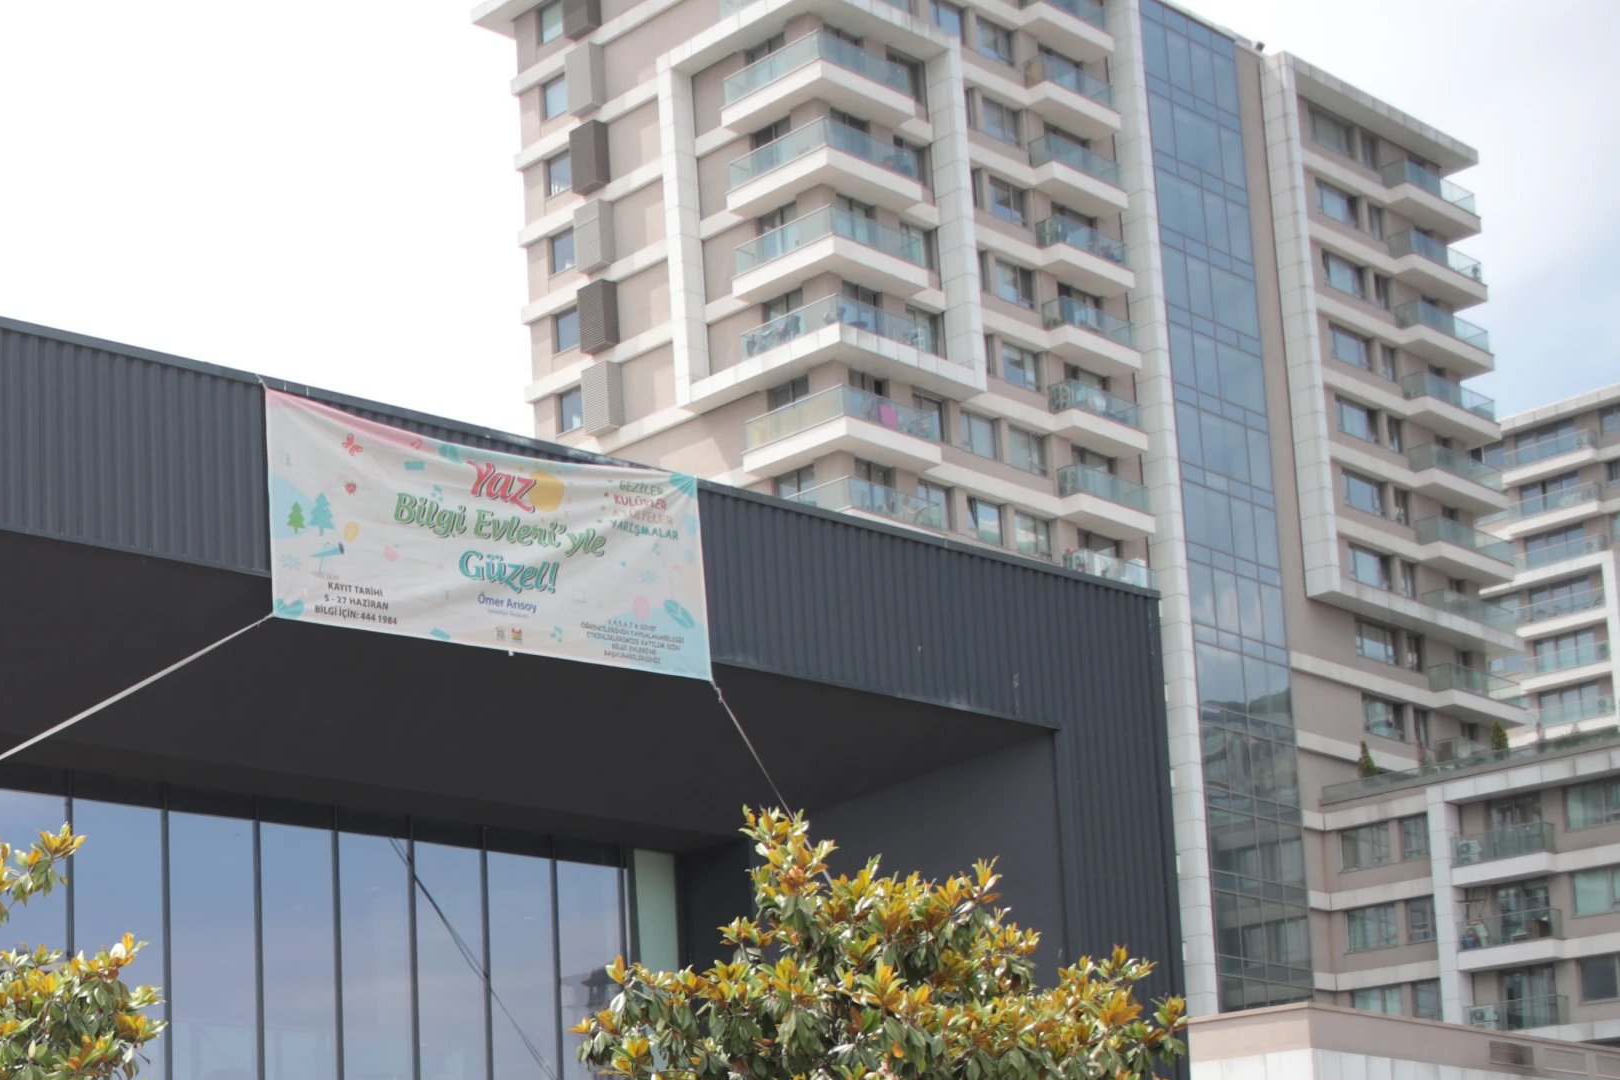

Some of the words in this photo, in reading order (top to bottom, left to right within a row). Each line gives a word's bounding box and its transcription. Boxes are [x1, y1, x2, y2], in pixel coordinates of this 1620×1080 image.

[466, 460, 536, 514] Yaz
[393, 493, 467, 538] Bilgi
[609, 519, 679, 541] YARIŞMALAR
[458, 549, 560, 594] Güzel!
[327, 581, 353, 593] KAYIT
[354, 585, 383, 597] TARİHİ
[477, 591, 504, 607] Ömer
[324, 594, 329, 602] 5
[336, 596, 347, 604] 27
[349, 596, 389, 611] HAZİRAN
[314, 604, 337, 617] BİLGİ
[338, 606, 359, 620] İÇİN:
[360, 611, 376, 622] 444
[378, 615, 398, 625] 1984
